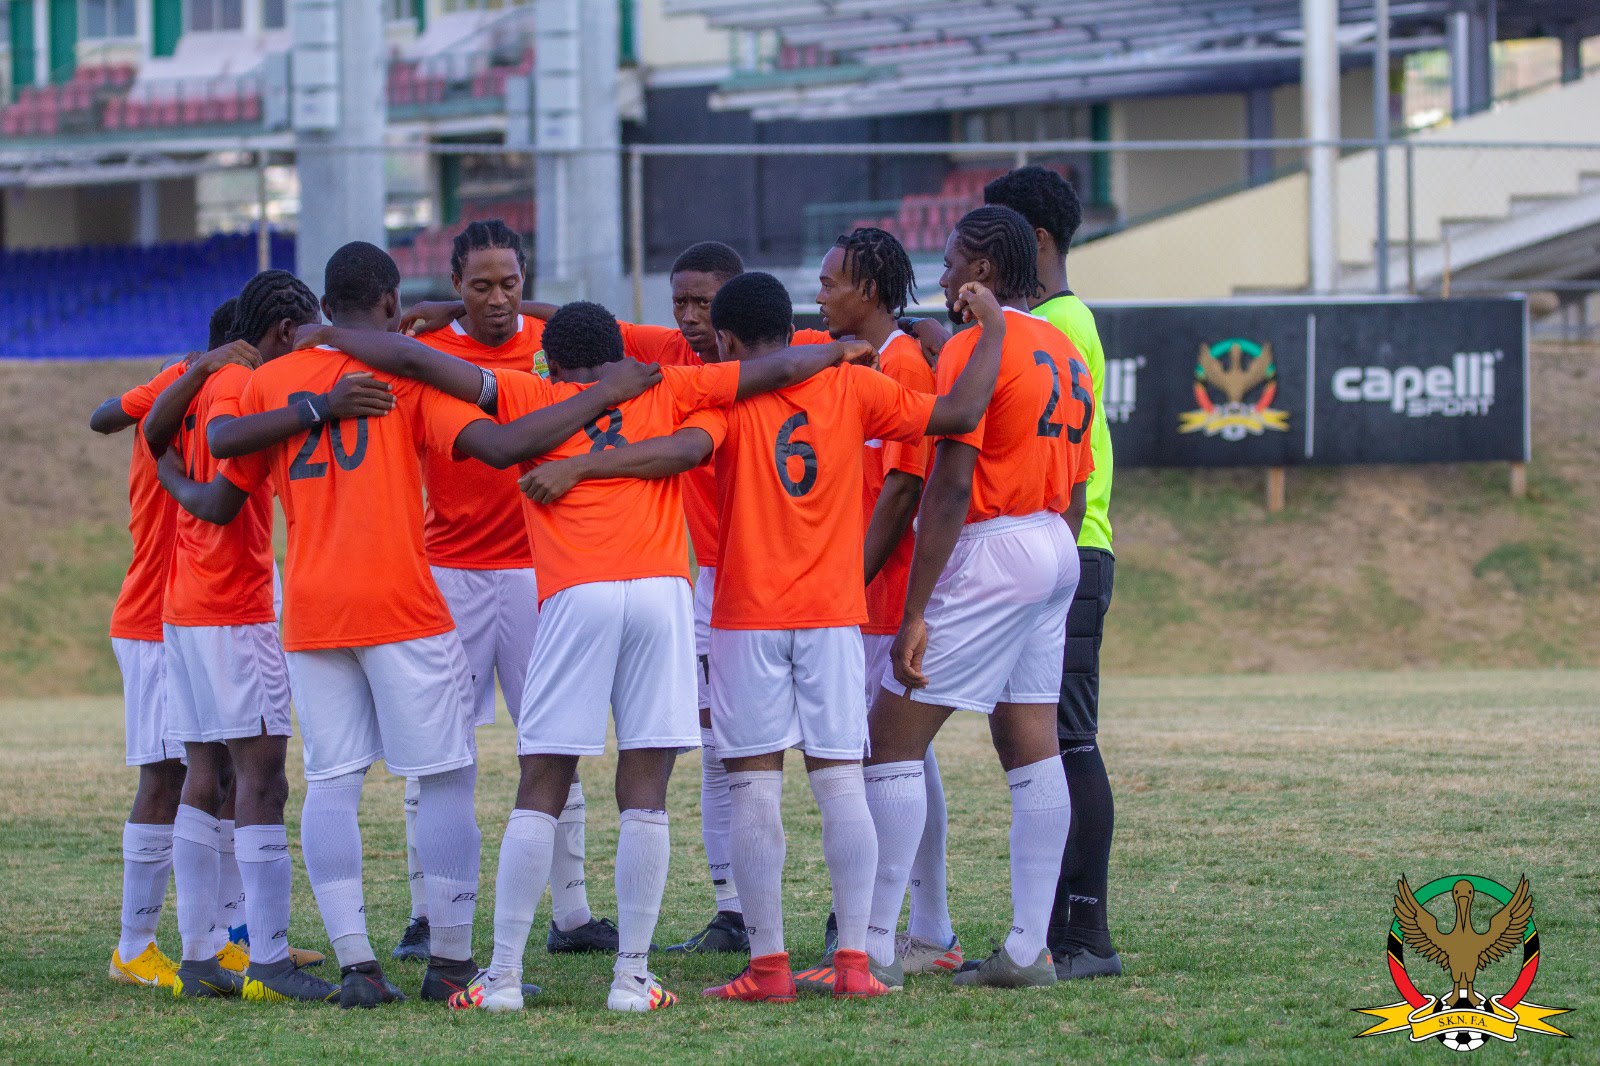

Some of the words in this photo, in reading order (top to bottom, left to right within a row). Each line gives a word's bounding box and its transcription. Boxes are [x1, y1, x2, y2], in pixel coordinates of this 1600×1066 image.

[1032, 350, 1093, 444] 25
[1332, 352, 1495, 413] capelli
[1407, 398, 1494, 417] SPORT
[287, 391, 369, 481] 20
[584, 407, 630, 454] 8
[774, 410, 818, 498] 6
